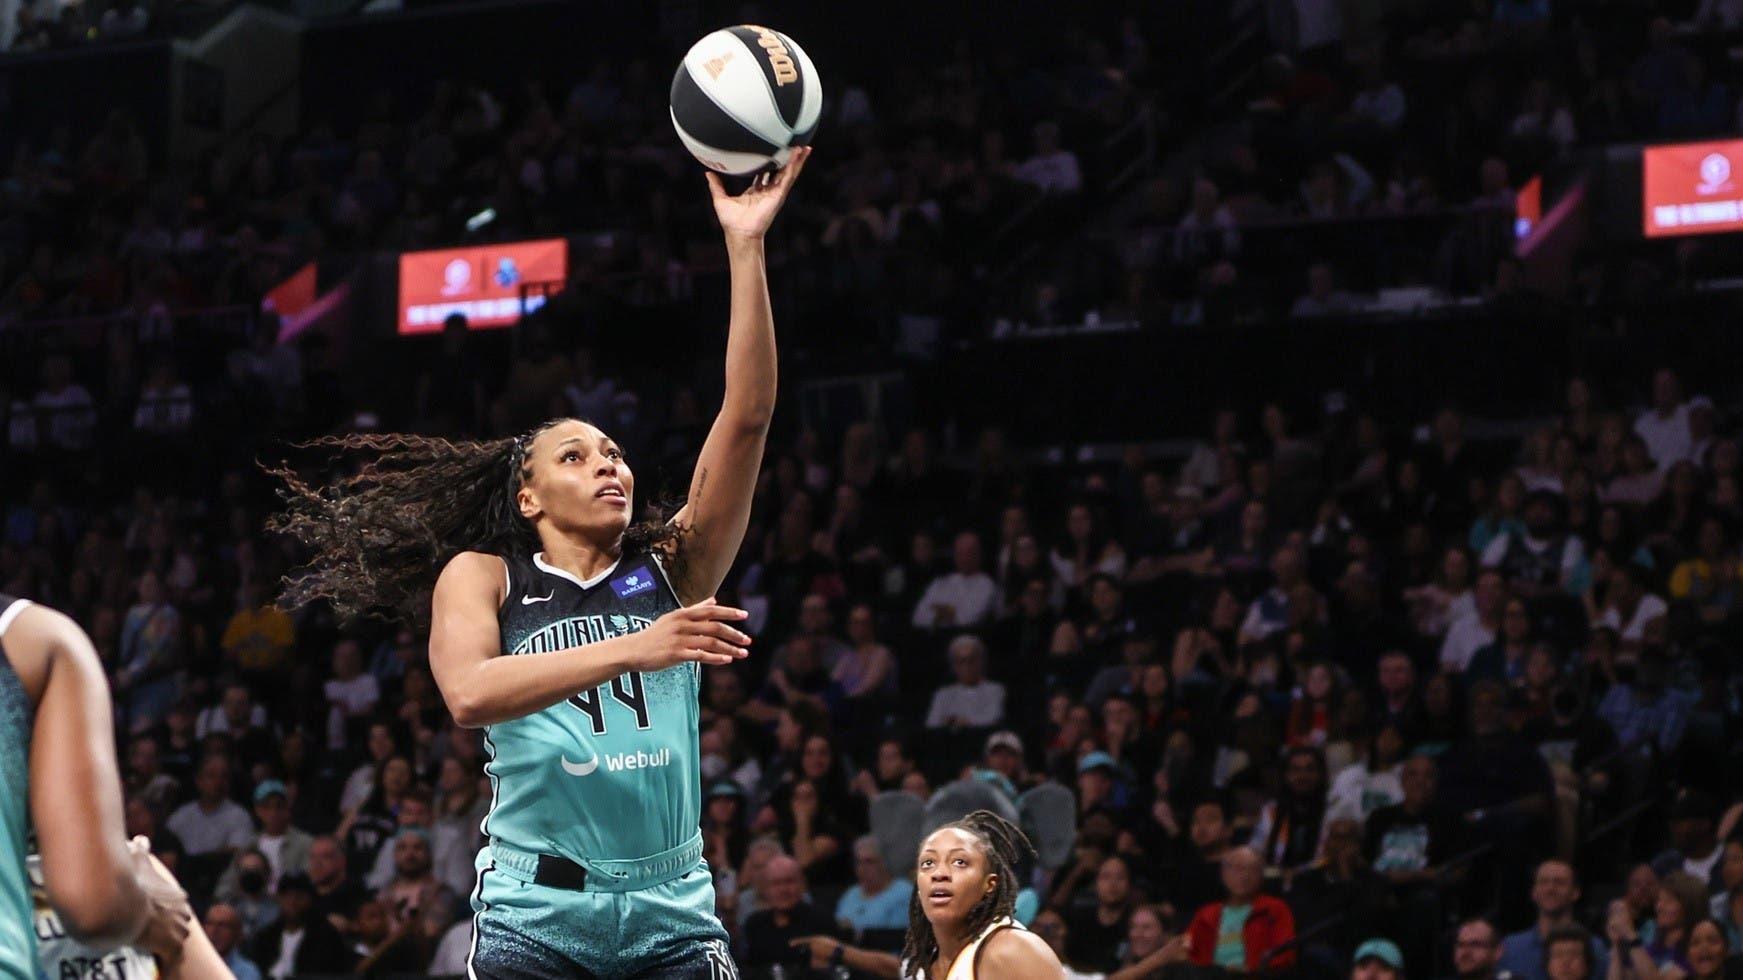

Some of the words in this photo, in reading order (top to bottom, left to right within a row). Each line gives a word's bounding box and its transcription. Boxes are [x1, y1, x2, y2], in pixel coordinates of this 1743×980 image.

[621, 581, 652, 597] BARCLAYS
[604, 748, 670, 772] Webull
[60, 956, 127, 980] AT&T
